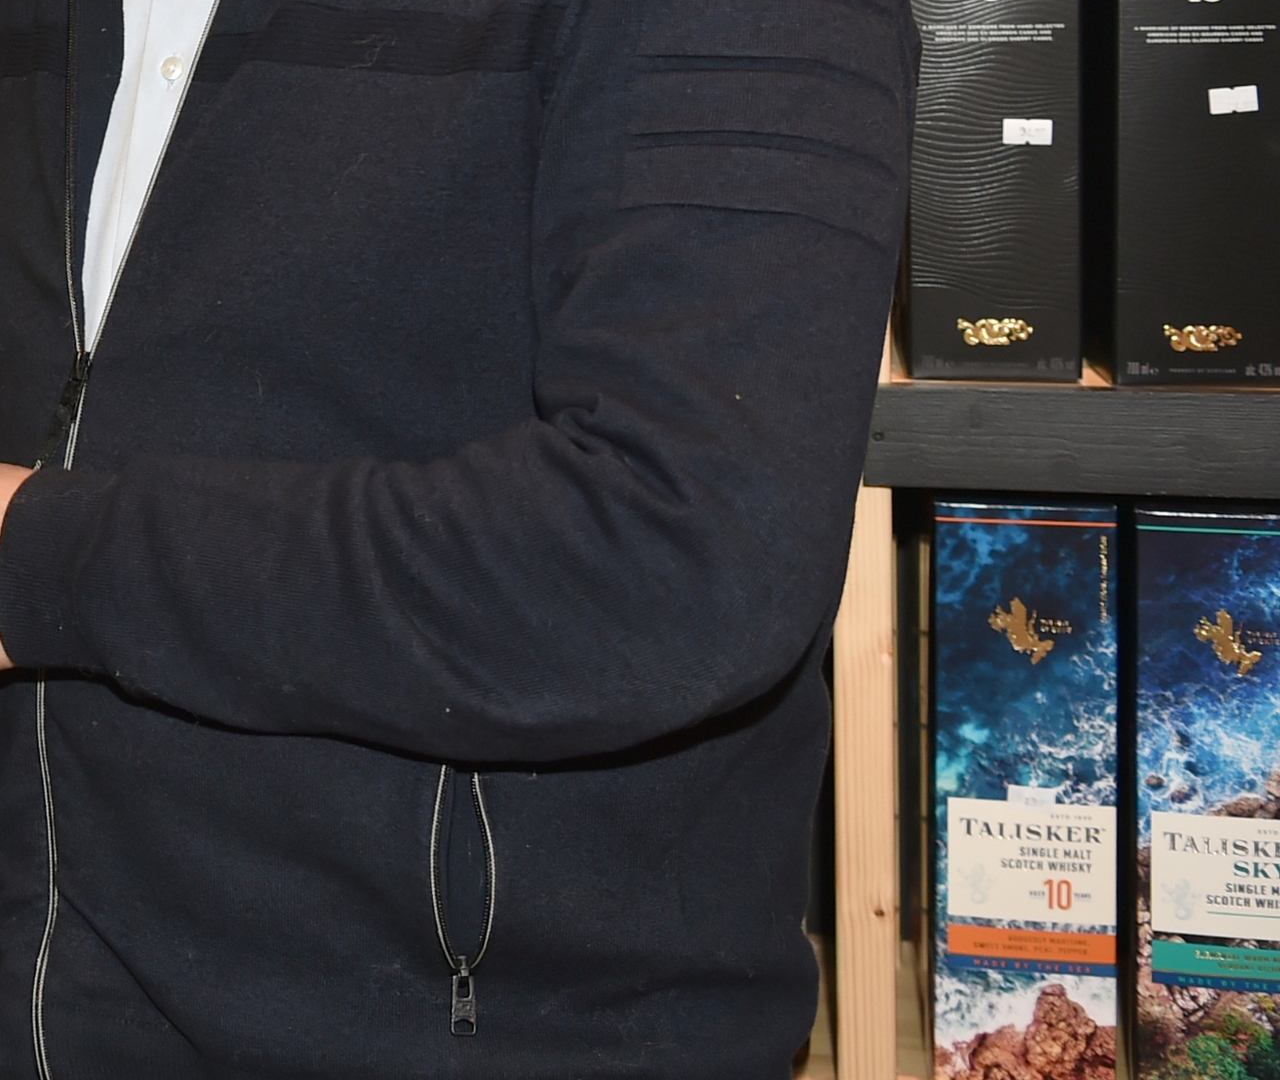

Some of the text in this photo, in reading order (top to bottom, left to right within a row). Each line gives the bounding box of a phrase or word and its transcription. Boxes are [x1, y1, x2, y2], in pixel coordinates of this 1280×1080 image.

[959, 816, 1102, 845] TALISKER
[1163, 831, 1280, 858] TALISK
[1019, 846, 1093, 861] SINGLE MALT
[1000, 859, 1093, 874] SCOTCH WHISKY
[1043, 879, 1073, 911] 10
[1225, 882, 1268, 896] SINGLE
[1206, 894, 1251, 908] SCOTCH
[973, 958, 1093, 974] MADE BY THE SEA
[1178, 975, 1213, 986] MADE
